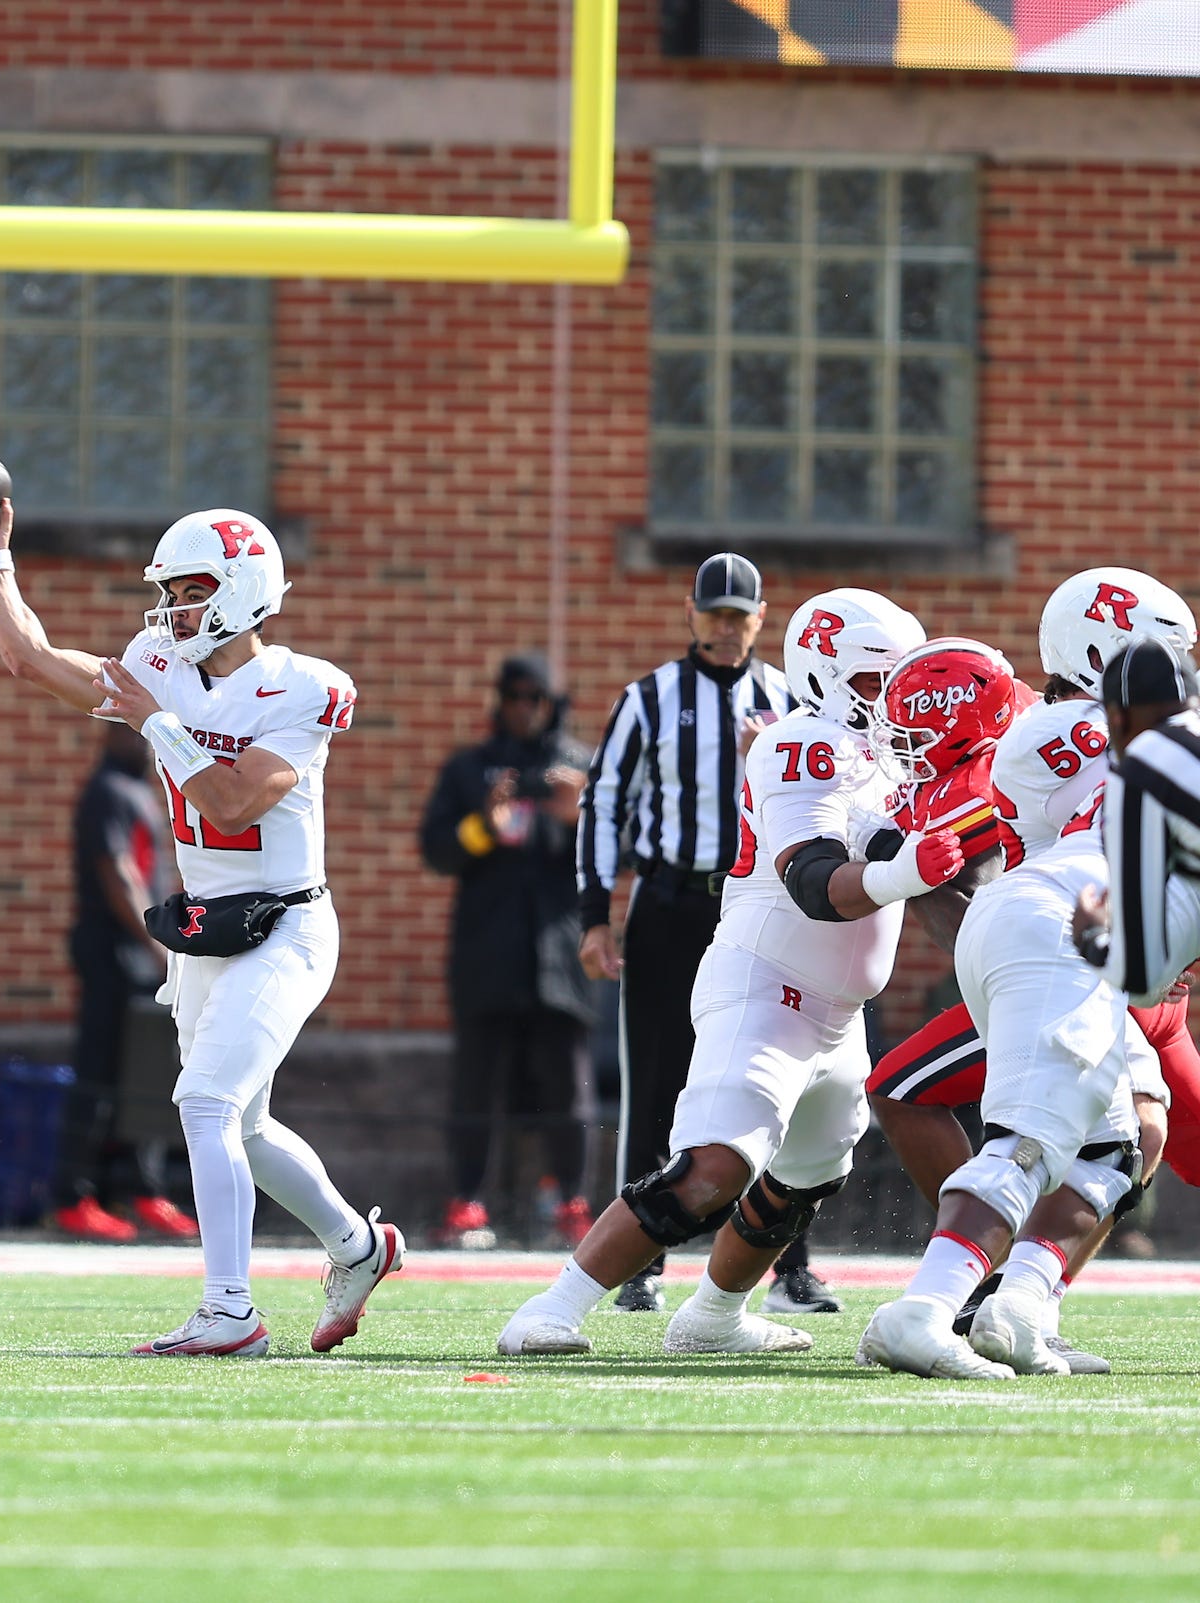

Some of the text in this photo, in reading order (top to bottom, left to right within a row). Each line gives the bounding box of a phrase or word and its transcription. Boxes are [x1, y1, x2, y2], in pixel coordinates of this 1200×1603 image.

[210, 520, 265, 559] R
[1084, 582, 1139, 632] R
[798, 608, 845, 658] R
[316, 686, 358, 729] 12
[902, 682, 976, 720] Terps
[775, 741, 836, 782] 76
[1036, 720, 1109, 779] 56
[780, 984, 802, 1012] R
